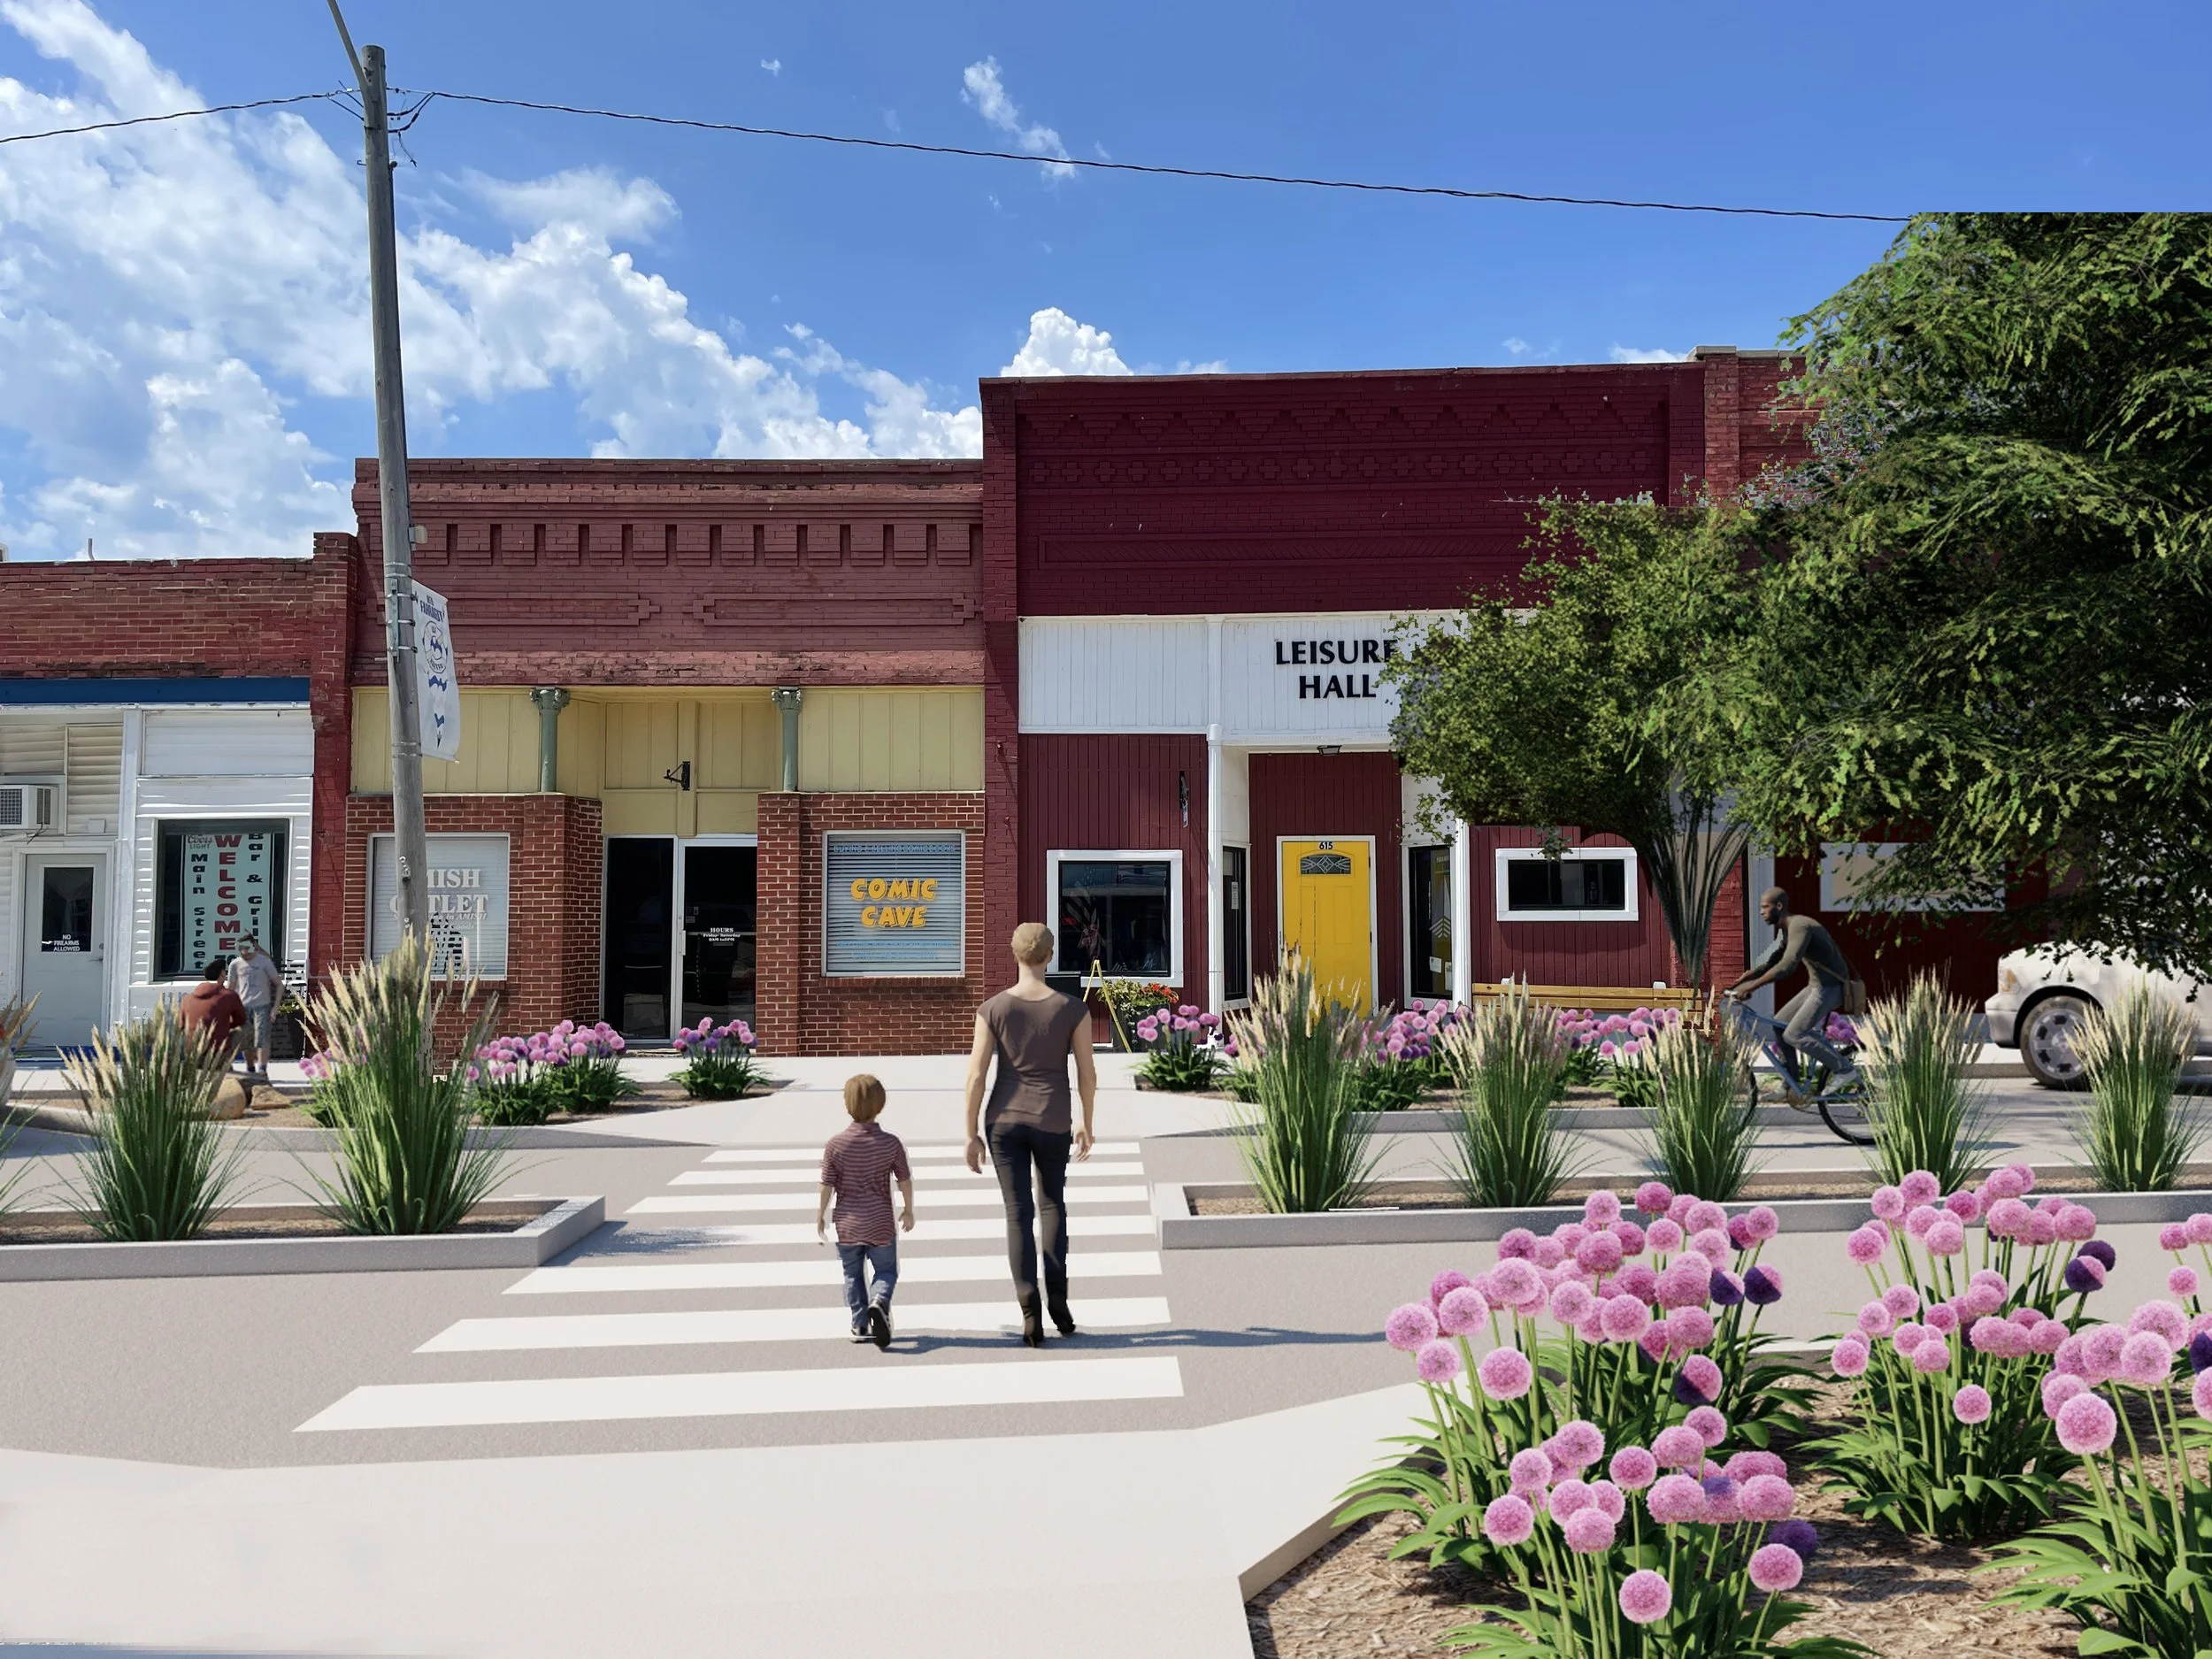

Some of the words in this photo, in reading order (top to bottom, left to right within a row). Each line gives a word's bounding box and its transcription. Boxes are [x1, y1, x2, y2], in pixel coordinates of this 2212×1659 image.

[1275, 639, 1398, 665] LEISURE
[1299, 674, 1377, 699] HALL
[248, 833, 264, 862] Bar
[1318, 841, 1333, 850] 615
[191, 854, 208, 895] Main
[246, 874, 264, 884] &
[214, 834, 242, 950] WELCOME
[850, 877, 938, 902] COMIC
[248, 895, 263, 945] Gril
[861, 905, 928, 928] CAVE
[193, 907, 206, 969] Street
